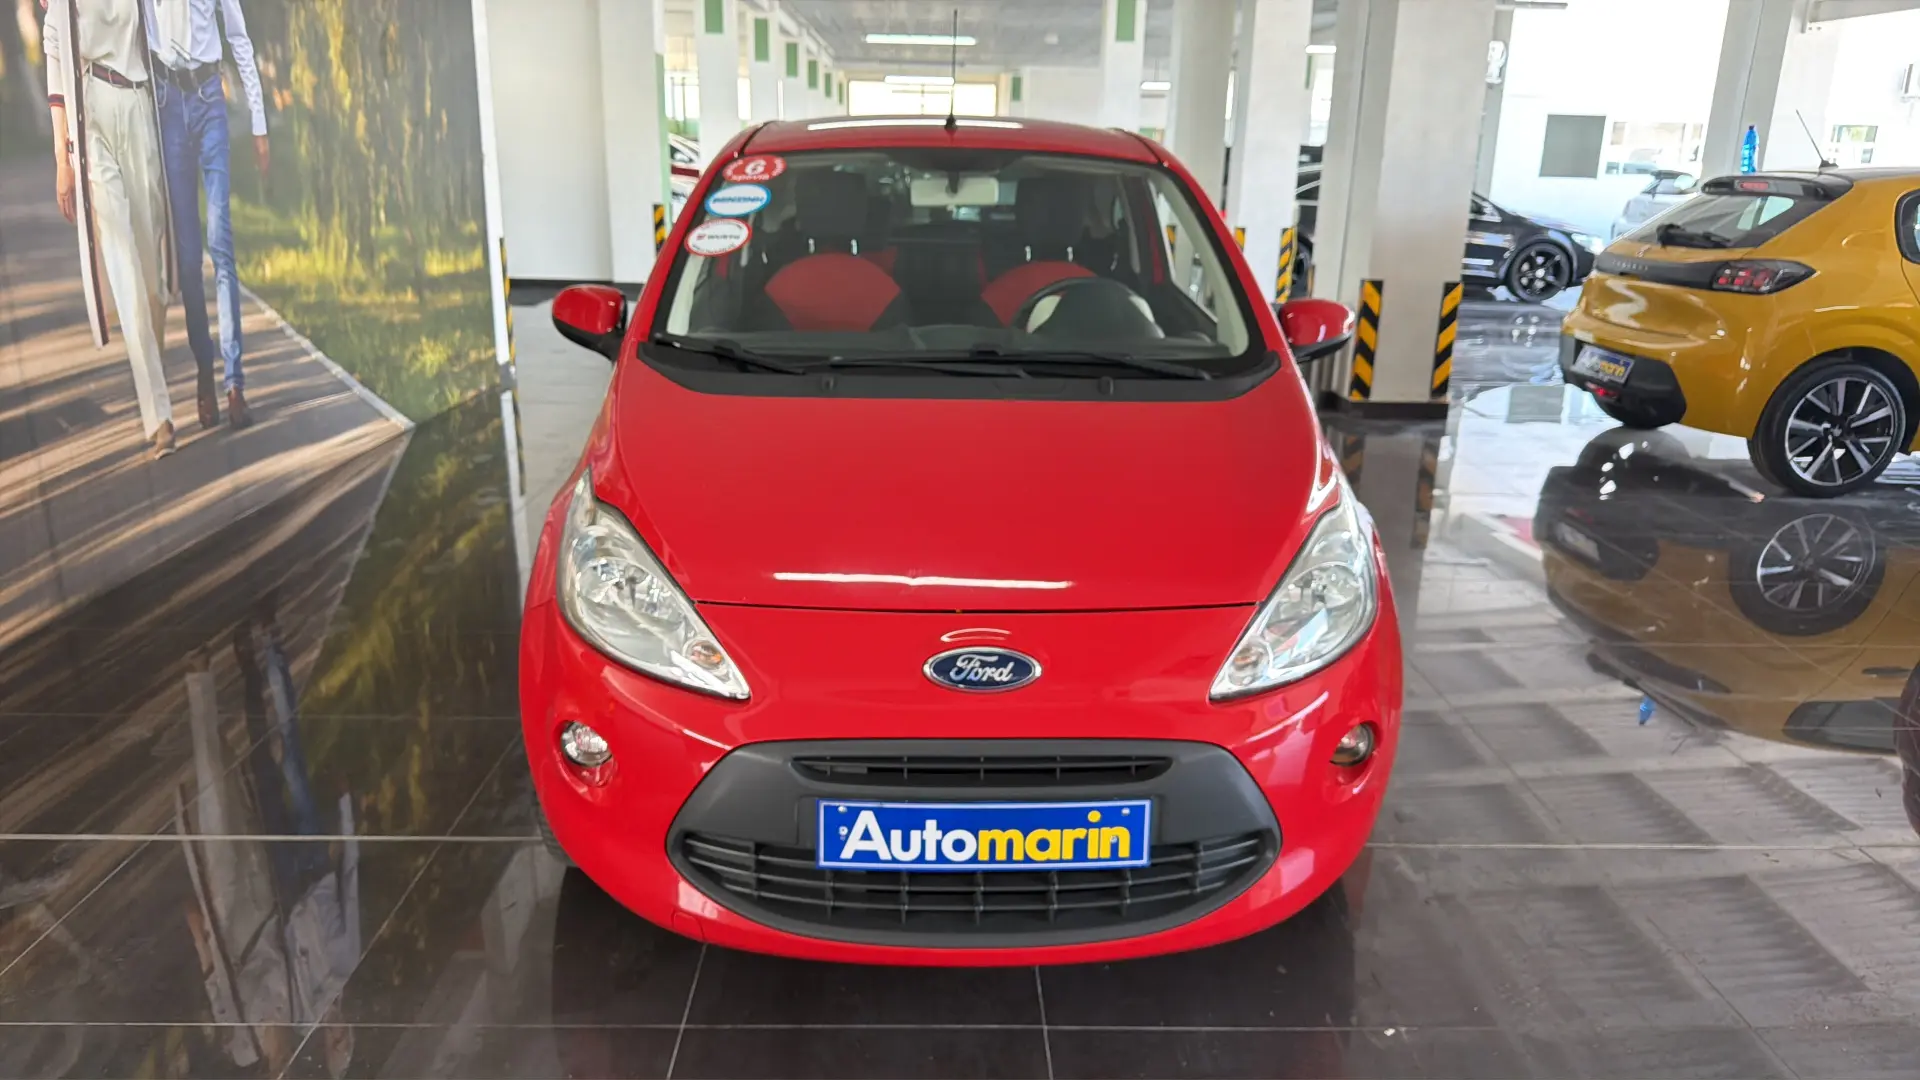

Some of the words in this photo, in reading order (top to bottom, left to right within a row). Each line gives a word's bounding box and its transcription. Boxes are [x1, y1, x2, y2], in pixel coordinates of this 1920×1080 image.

[745, 159, 767, 177] 6
[949, 653, 1015, 682] Ford
[839, 809, 1131, 862] Automarin
